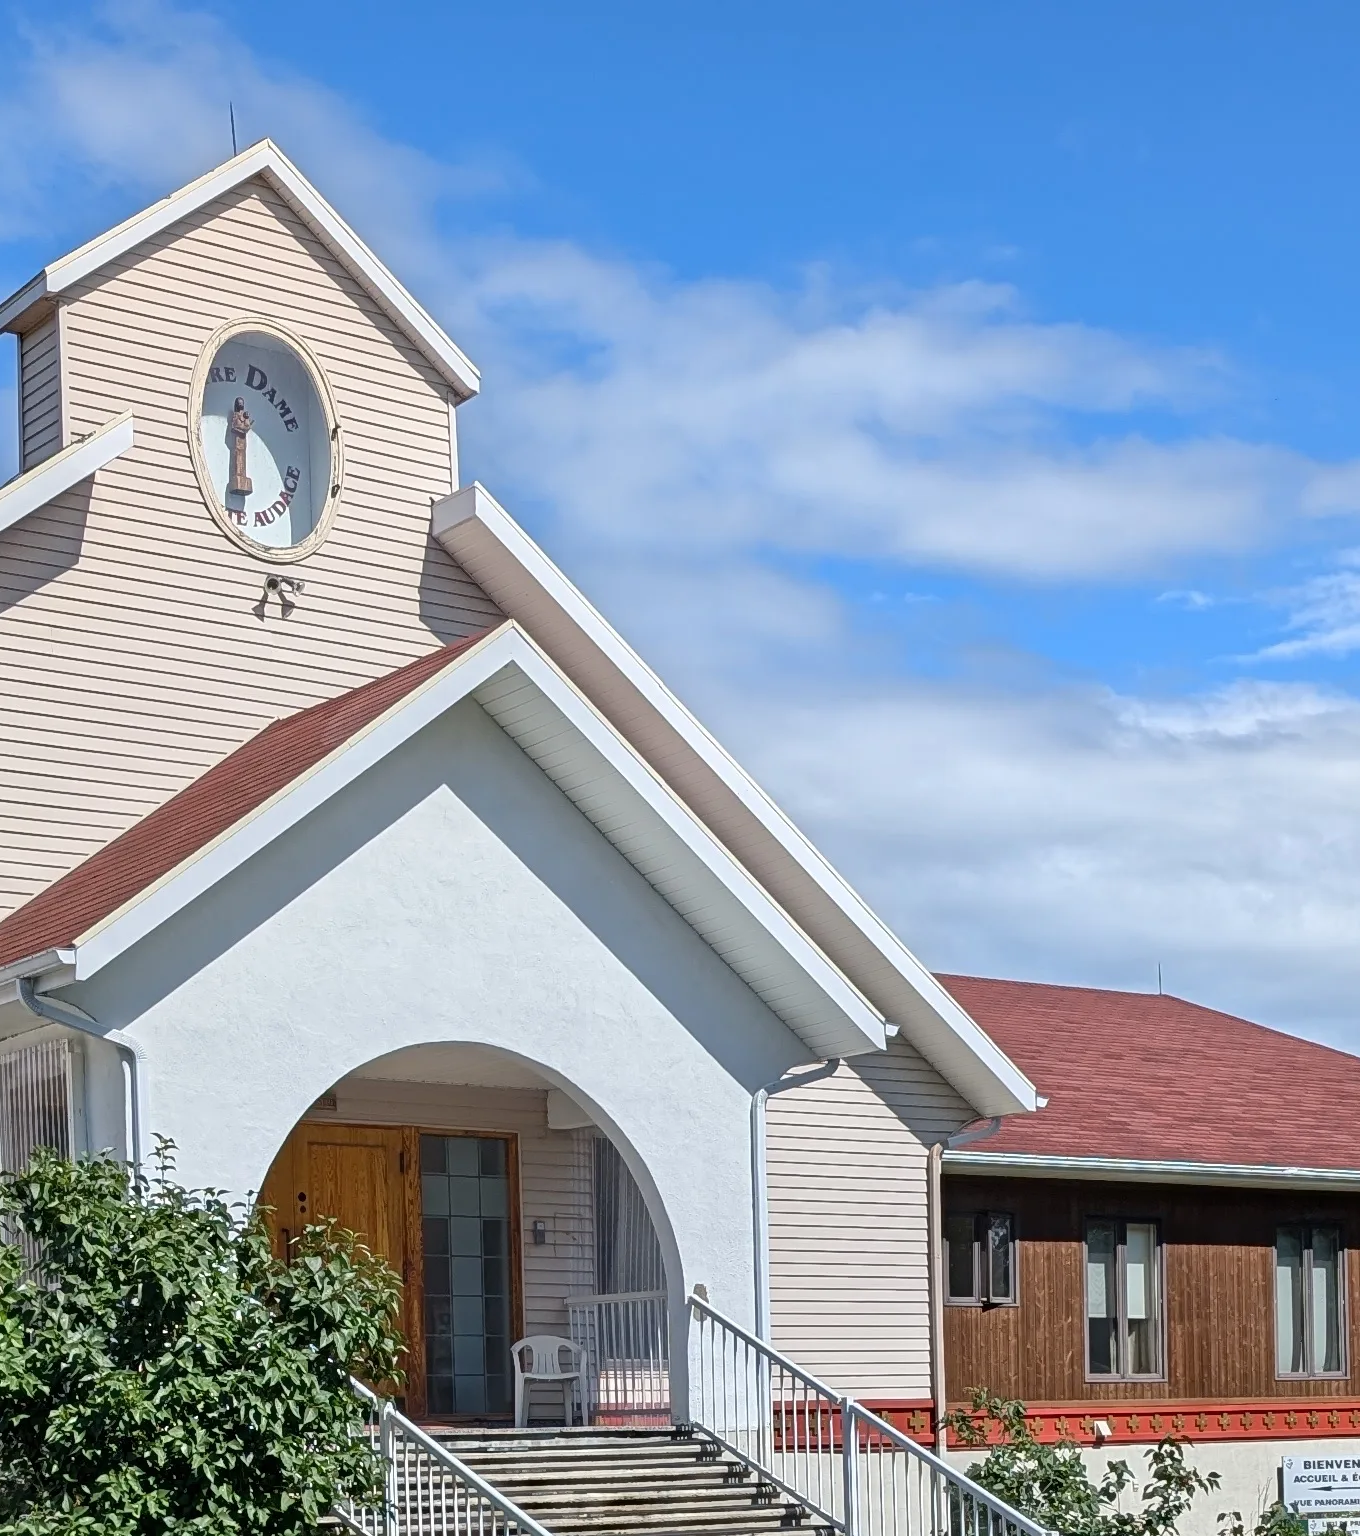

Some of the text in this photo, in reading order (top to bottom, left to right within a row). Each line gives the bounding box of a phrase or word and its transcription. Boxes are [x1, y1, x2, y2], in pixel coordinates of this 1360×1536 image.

[207, 364, 299, 433] RE DAME
[253, 465, 301, 528] AUDACE
[1293, 1474, 1339, 1483] ACCUEIL
[1341, 1474, 1349, 1482] &
